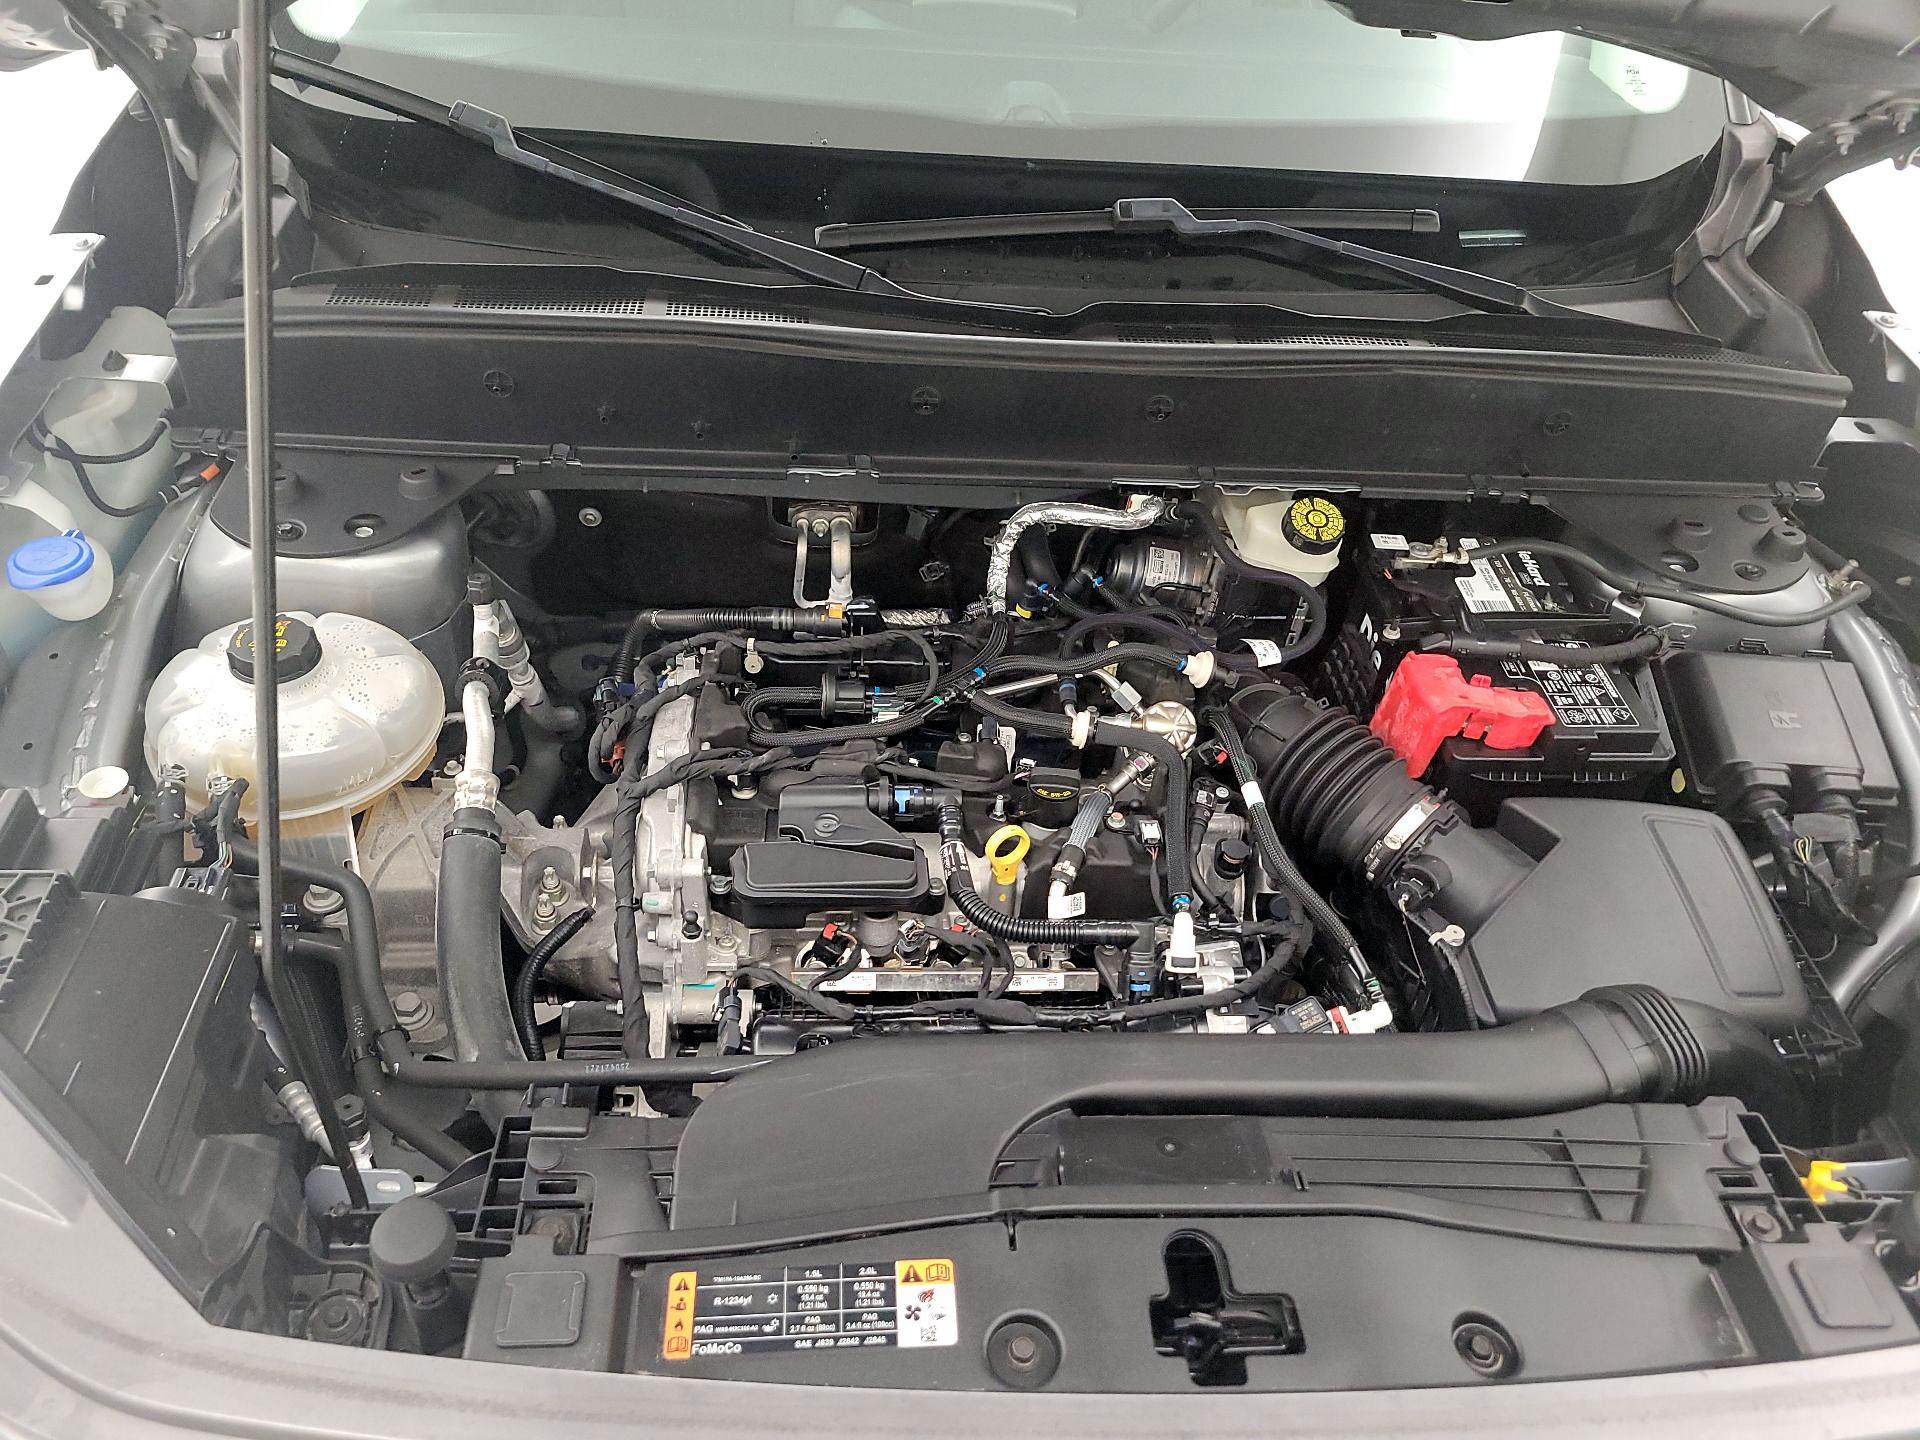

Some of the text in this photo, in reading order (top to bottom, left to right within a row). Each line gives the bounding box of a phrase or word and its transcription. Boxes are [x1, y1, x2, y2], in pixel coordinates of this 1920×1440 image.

[1517, 551, 1550, 586] ieHard
[875, 1281, 885, 1292] kg
[713, 1294, 753, 1306] R-1234yf
[694, 1325, 714, 1334] PAG
[691, 1342, 742, 1354] FoMoCo
